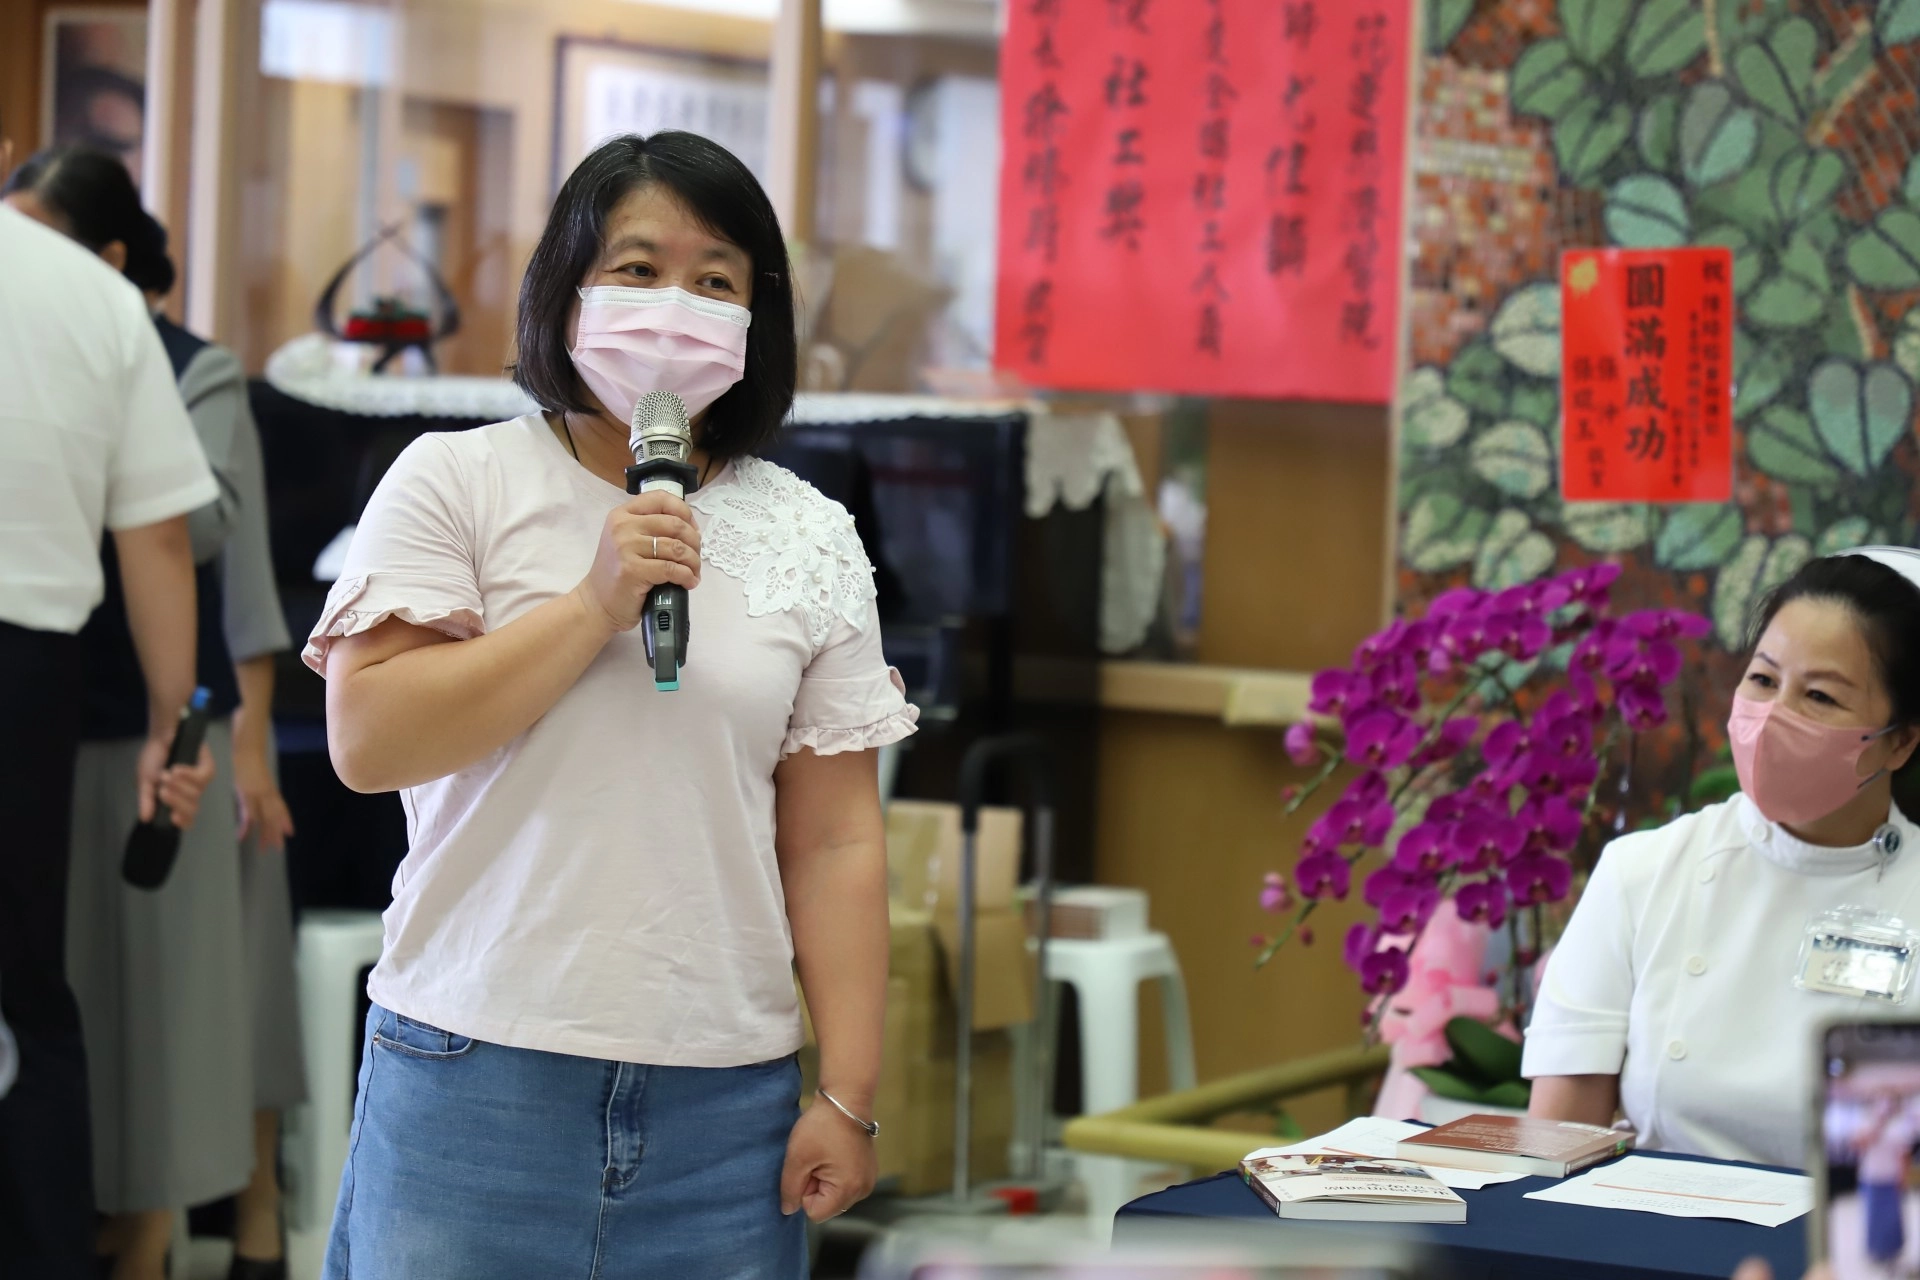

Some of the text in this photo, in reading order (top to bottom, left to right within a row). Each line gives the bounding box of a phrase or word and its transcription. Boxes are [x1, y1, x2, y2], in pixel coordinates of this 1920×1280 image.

[1191, 0, 1239, 359] 度全國社工人員
[1626, 263, 1667, 460] 圓滿成功
